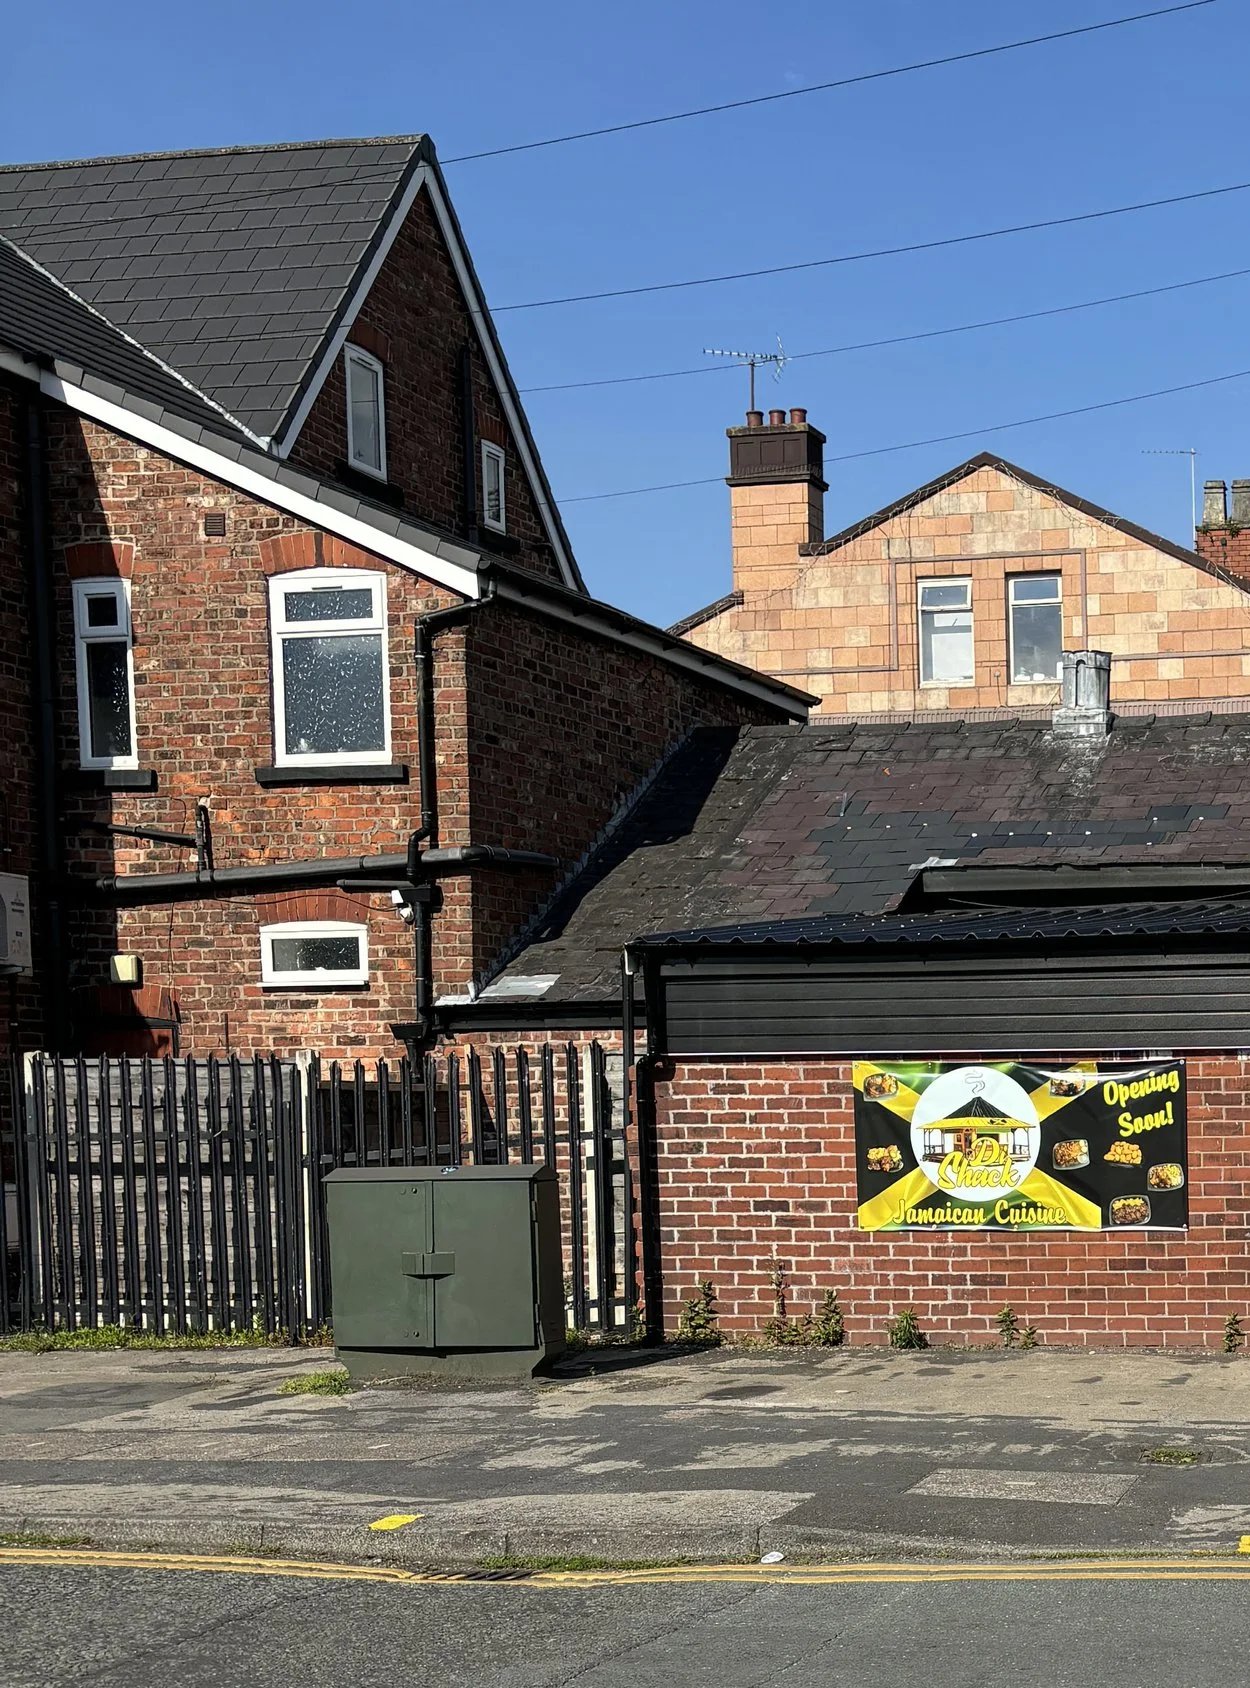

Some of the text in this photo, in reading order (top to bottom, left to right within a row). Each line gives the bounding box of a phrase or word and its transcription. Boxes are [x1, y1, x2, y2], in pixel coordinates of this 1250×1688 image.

[1103, 1070, 1180, 1108] Opening
[1118, 1101, 1174, 1137] Soon!
[938, 1151, 1021, 1190] Shack
[892, 1199, 1068, 1225] Jamaican Cuisine
